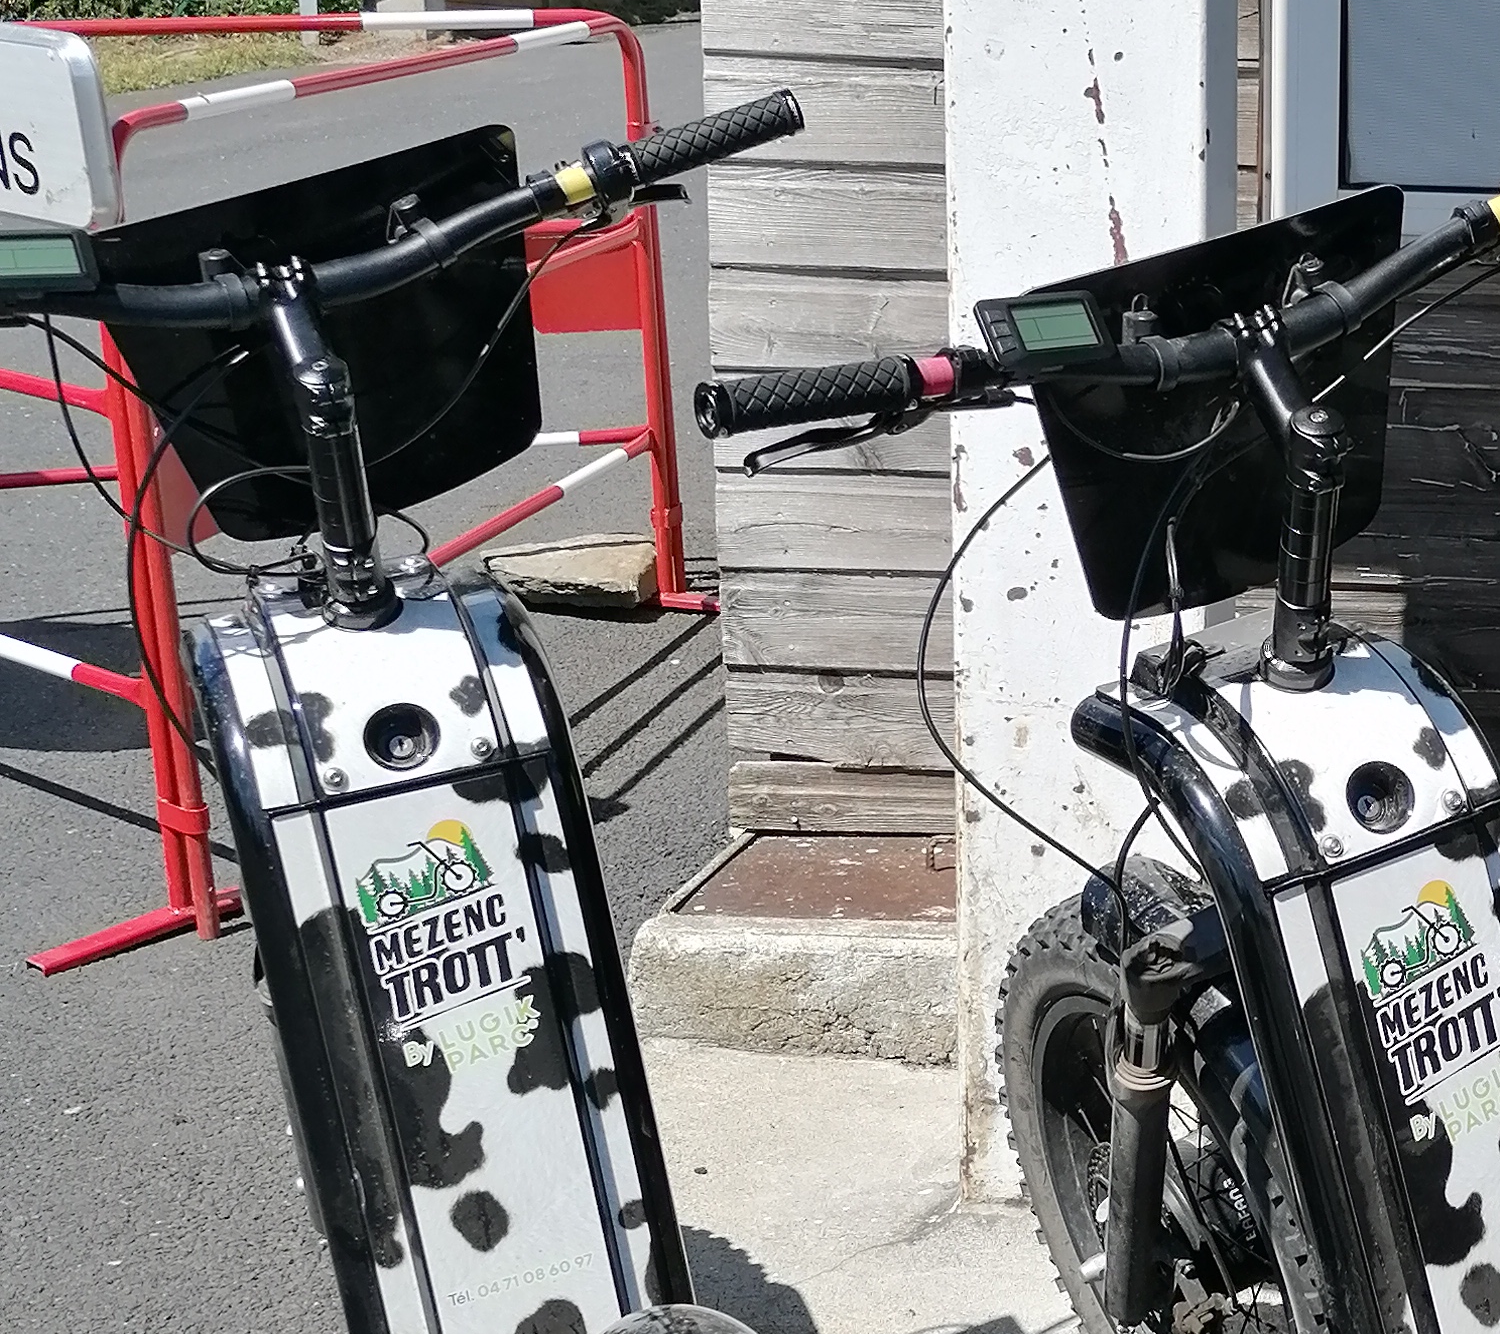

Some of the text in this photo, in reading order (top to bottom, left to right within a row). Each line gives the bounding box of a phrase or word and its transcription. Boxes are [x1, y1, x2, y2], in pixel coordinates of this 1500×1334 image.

[0, 130, 40, 196] S
[374, 893, 506, 971] MEZENC
[385, 927, 525, 1018] TROTT'
[1379, 952, 1489, 1045] MEZENC
[404, 995, 541, 1067] By LUGIK
[1411, 1112, 1436, 1140] By
